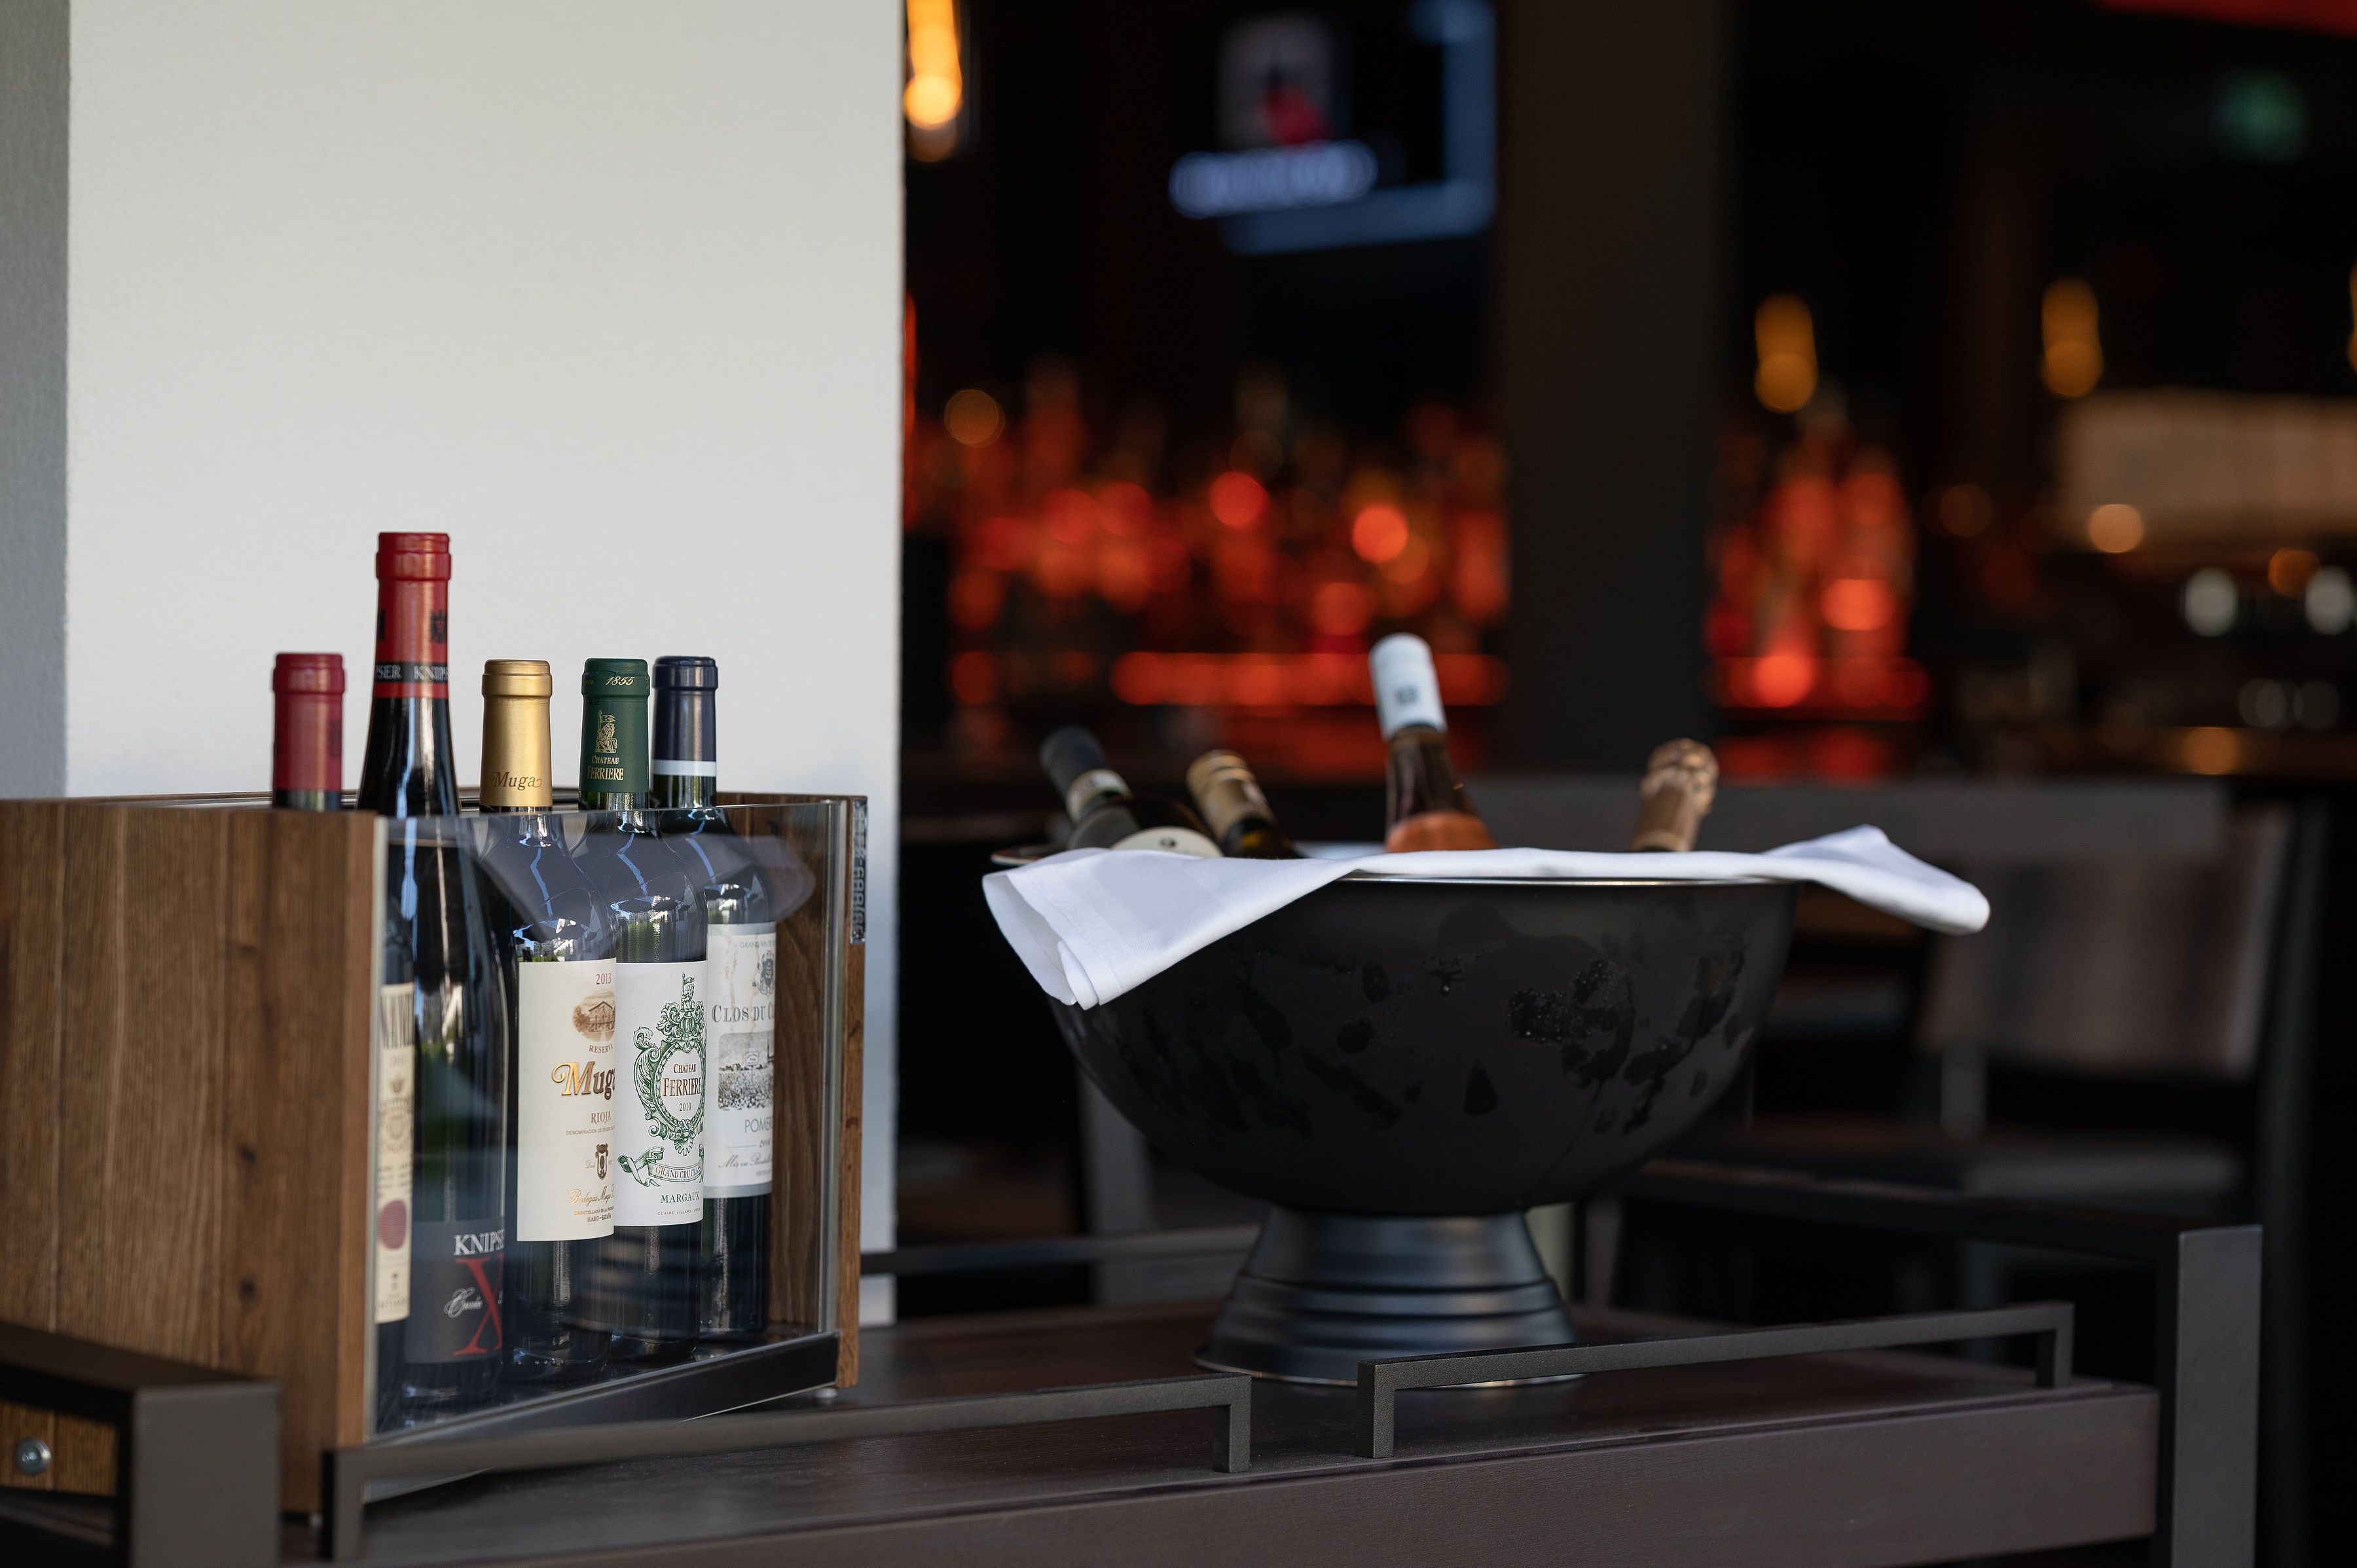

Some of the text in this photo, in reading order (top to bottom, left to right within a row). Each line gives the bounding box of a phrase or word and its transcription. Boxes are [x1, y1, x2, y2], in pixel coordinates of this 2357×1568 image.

[605, 676, 635, 685] 1855
[592, 756, 619, 765] CHATEAU
[587, 766, 624, 780] FERRIERE
[491, 771, 542, 791] Muga
[596, 972, 612, 985] 2013
[712, 1004, 749, 1023] CLOS
[753, 1006, 766, 1021] DU
[674, 1063, 697, 1074] CHATEAU
[663, 1077, 702, 1097] FERRIERE
[679, 1103, 692, 1112] 2010
[591, 1111, 612, 1124] RIOJA
[655, 1166, 679, 1178] GRAND
[680, 1170, 691, 1179] CRU
[661, 1192, 700, 1203] MARGAUX
